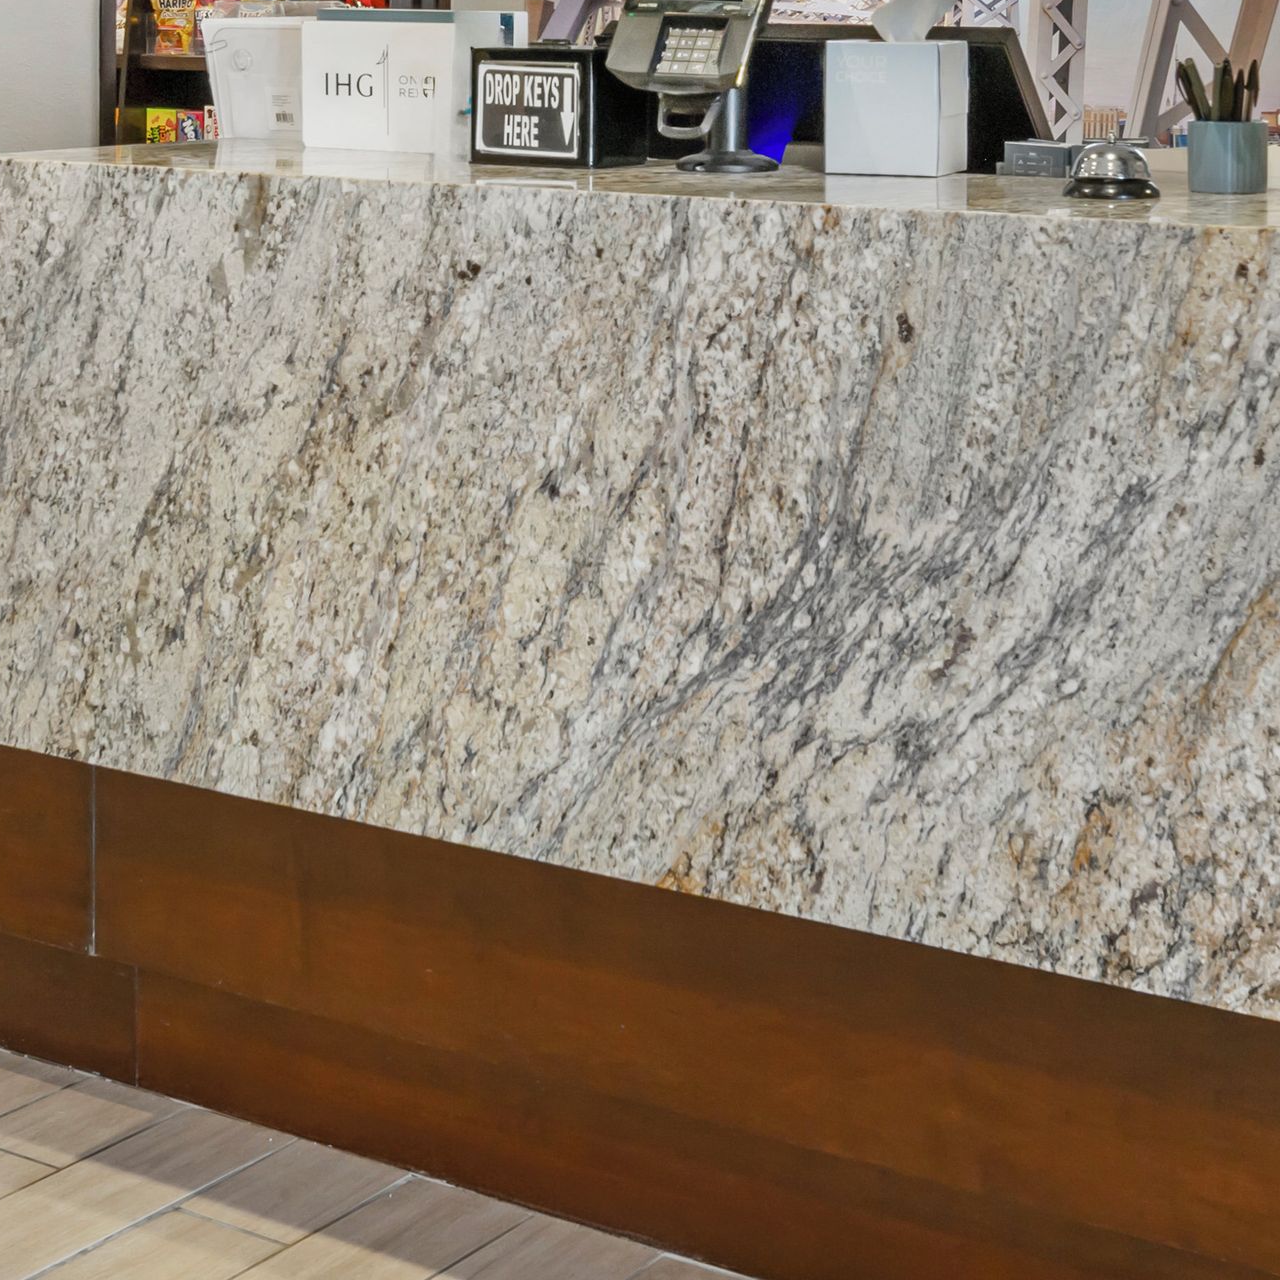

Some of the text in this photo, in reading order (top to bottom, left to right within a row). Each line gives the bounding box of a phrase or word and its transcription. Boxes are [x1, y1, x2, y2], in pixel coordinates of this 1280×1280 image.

[835, 55, 888, 69] YOUR
[324, 72, 375, 98] IHG
[835, 71, 888, 84] CHOICE
[485, 73, 560, 110] DROP KEYS
[503, 114, 540, 148] HERE
